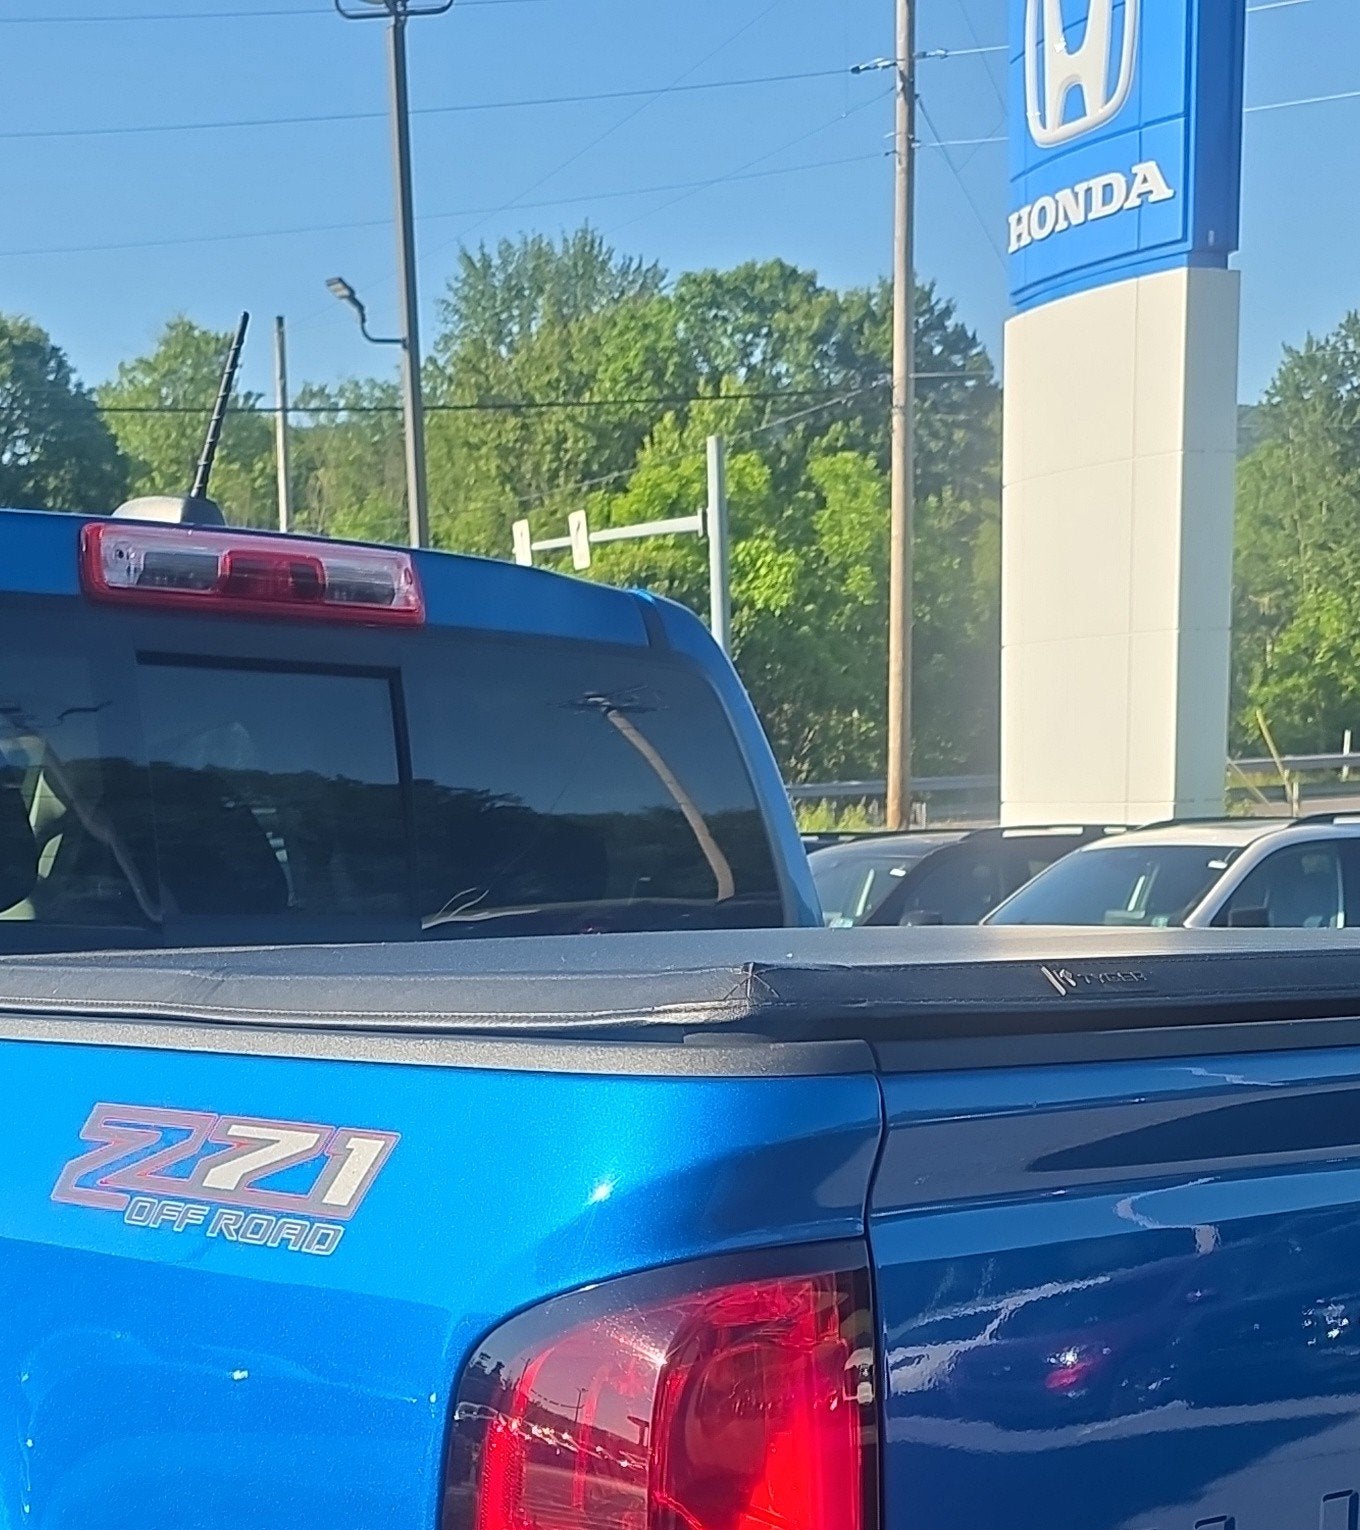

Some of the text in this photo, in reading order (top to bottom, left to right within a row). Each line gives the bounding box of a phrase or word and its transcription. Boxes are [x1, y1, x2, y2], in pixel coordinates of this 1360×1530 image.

[1007, 160, 1175, 254] HONDA
[50, 1101, 401, 1221] Z71
[124, 1195, 346, 1256] OFF ROAD
